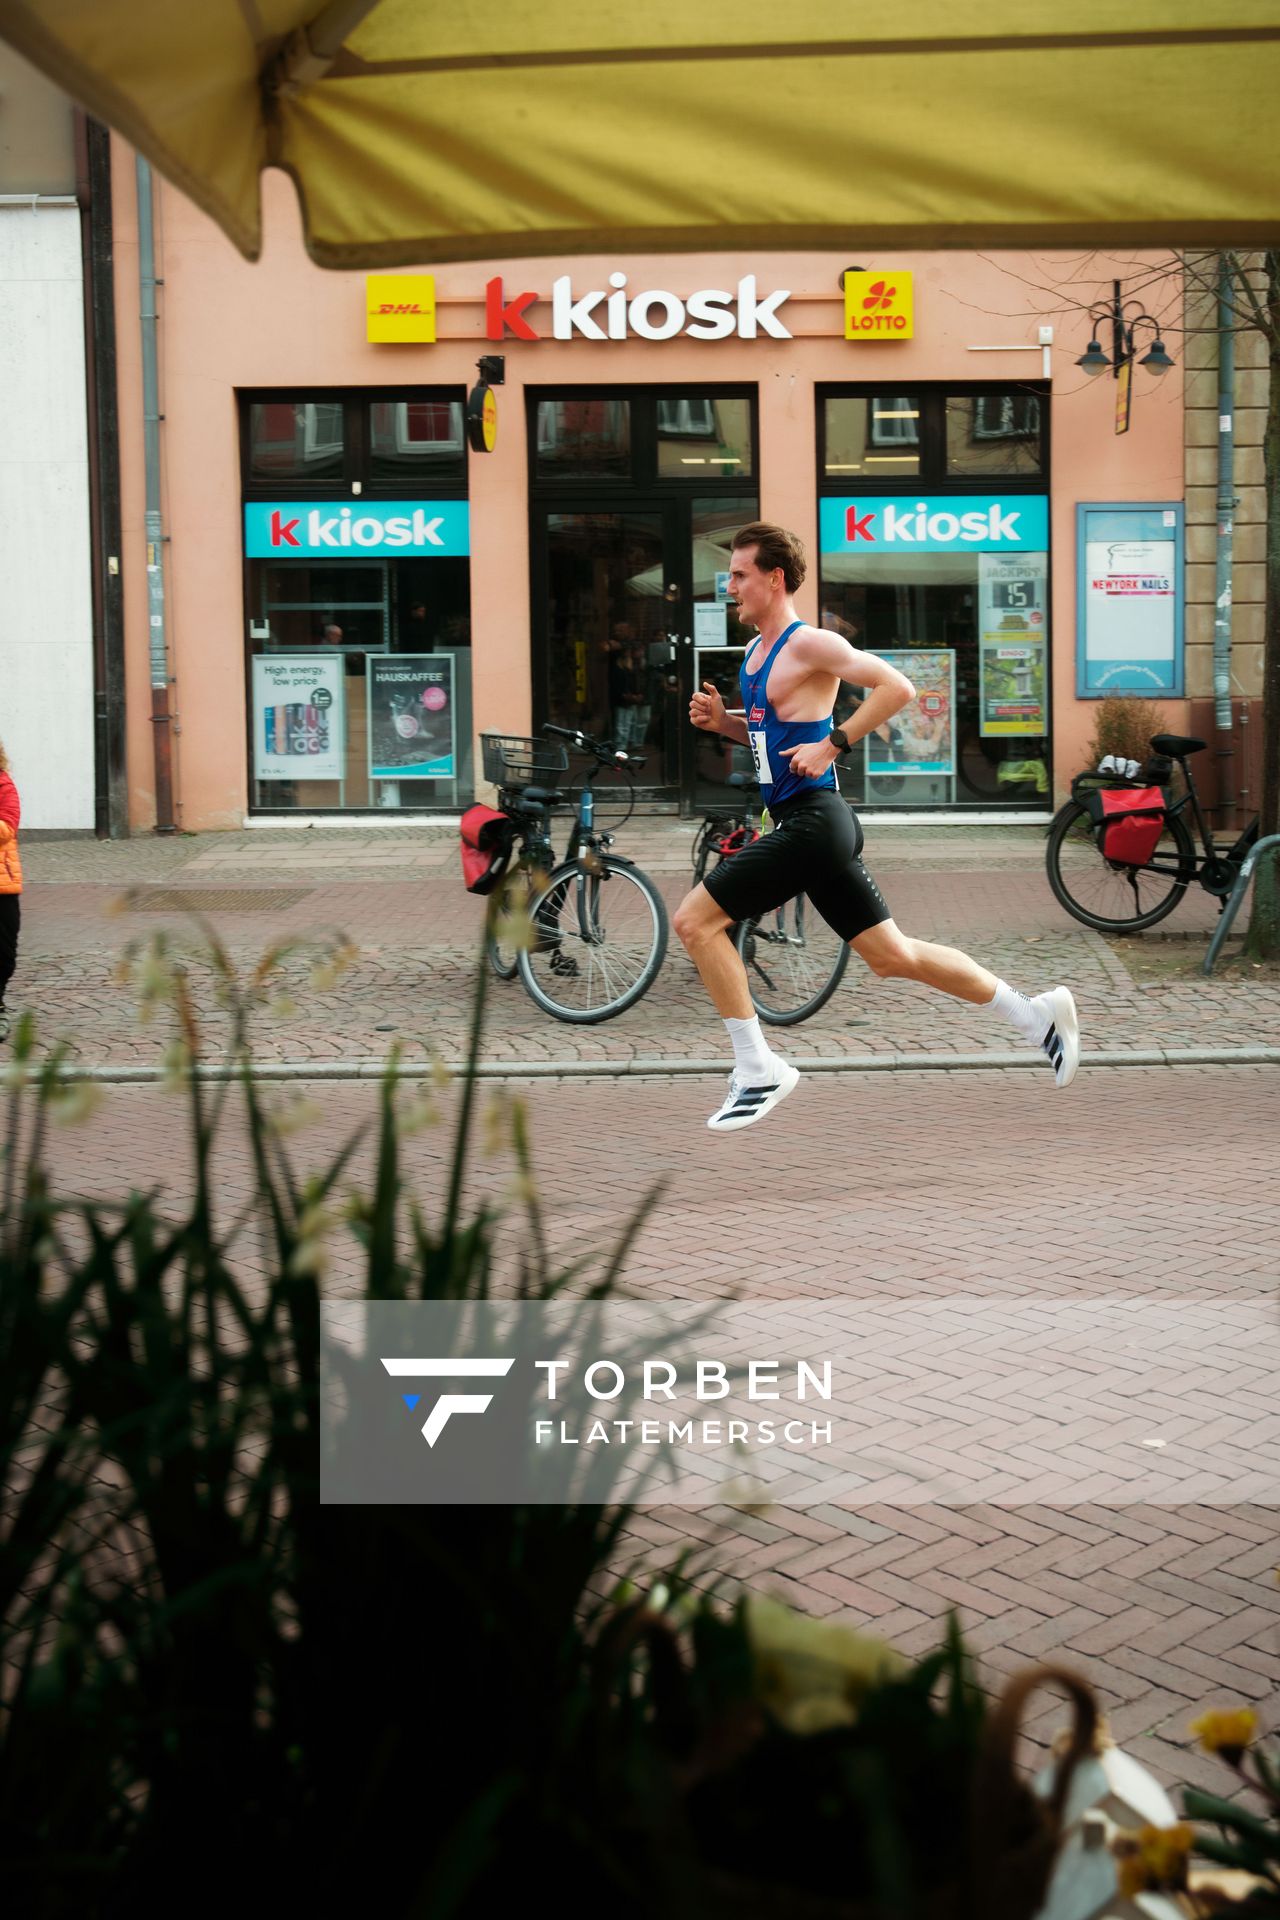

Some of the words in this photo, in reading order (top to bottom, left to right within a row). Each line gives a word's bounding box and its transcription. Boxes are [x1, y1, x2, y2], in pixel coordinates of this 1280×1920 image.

[379, 304, 421, 314] DHL
[486, 276, 541, 340] k
[553, 271, 793, 340] kiosk
[851, 315, 907, 330] LOTTO
[271, 510, 301, 546] k
[308, 507, 445, 546] kiosk
[845, 505, 876, 541] k
[883, 502, 1021, 541] kiosk
[987, 567, 1041, 578] JACKPOT
[1142, 580, 1169, 589] NAILS
[1007, 582, 1027, 607] 15
[264, 666, 287, 676] High
[273, 677, 289, 685] low
[293, 677, 318, 687] price
[376, 673, 443, 681] HAUSKAFFEE
